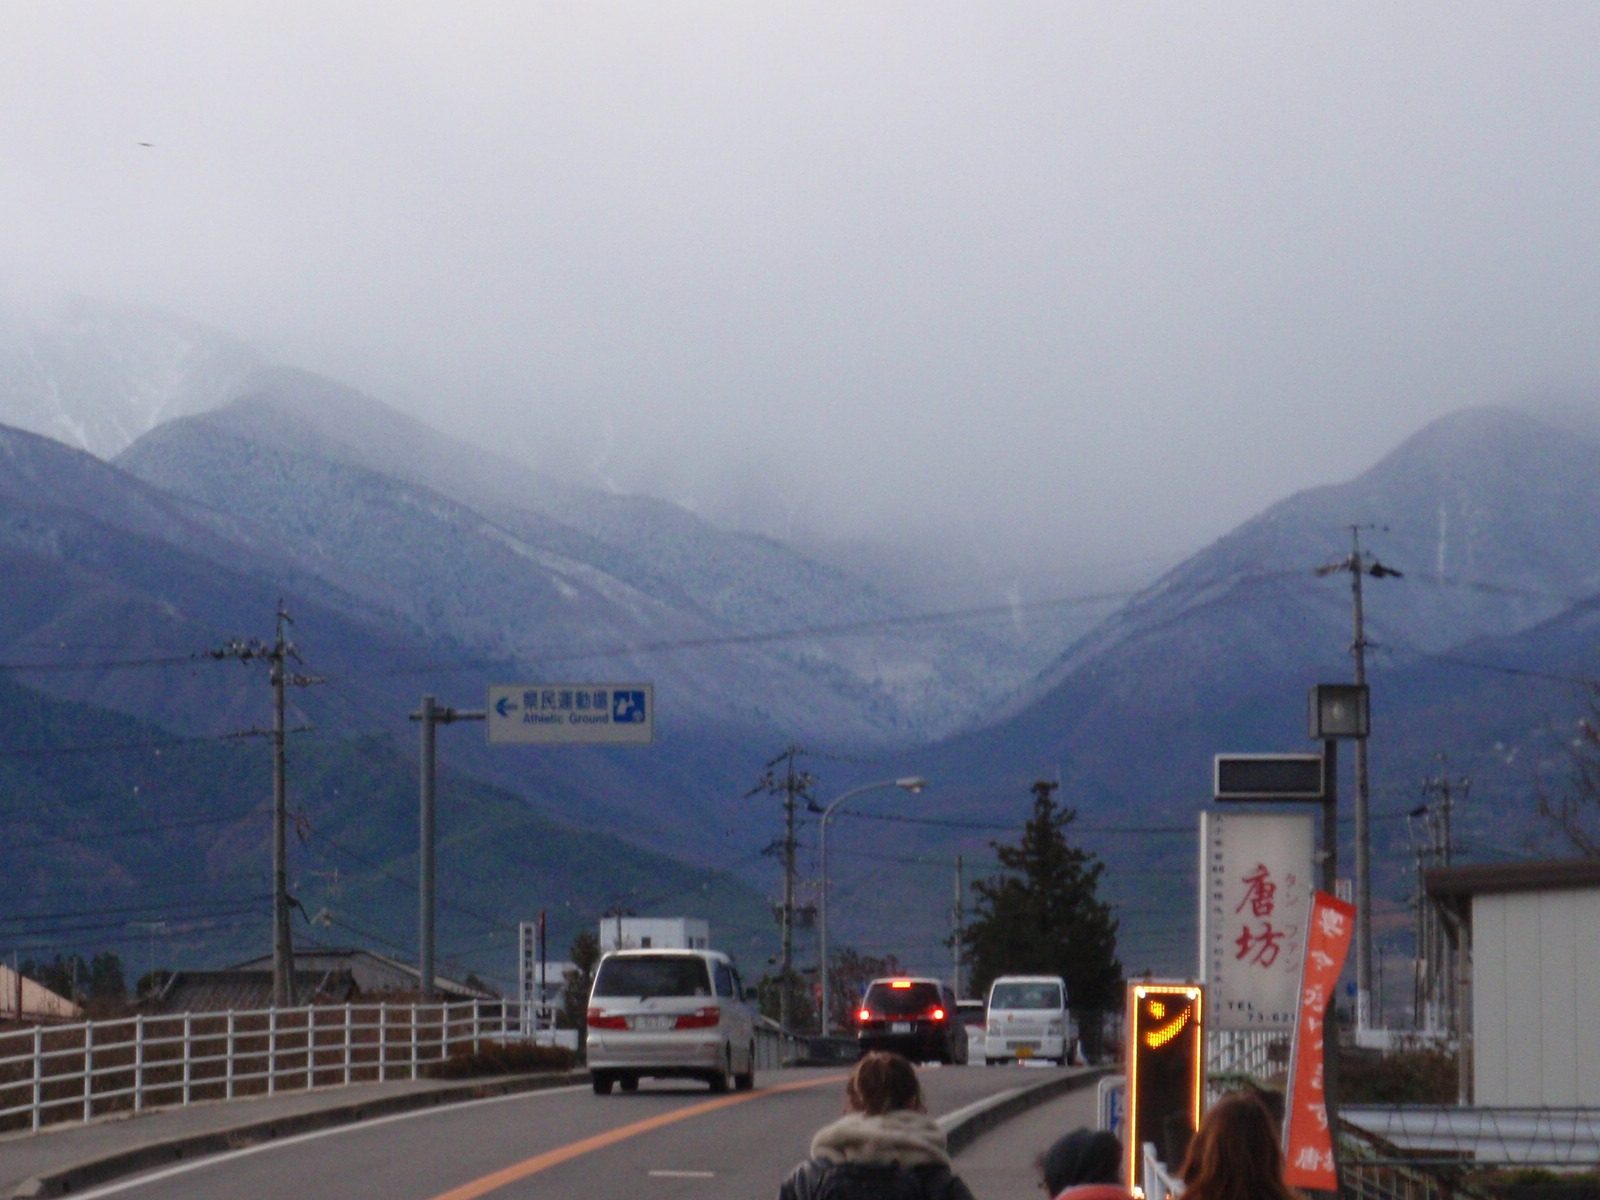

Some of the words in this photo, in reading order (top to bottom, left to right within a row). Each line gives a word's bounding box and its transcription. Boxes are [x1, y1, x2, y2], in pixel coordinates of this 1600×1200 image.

[523, 713, 562, 724] Athletic
[569, 713, 609, 724] Ground
[1235, 862, 1286, 969] 唐坊
[1227, 1001, 1254, 1011] TEL
